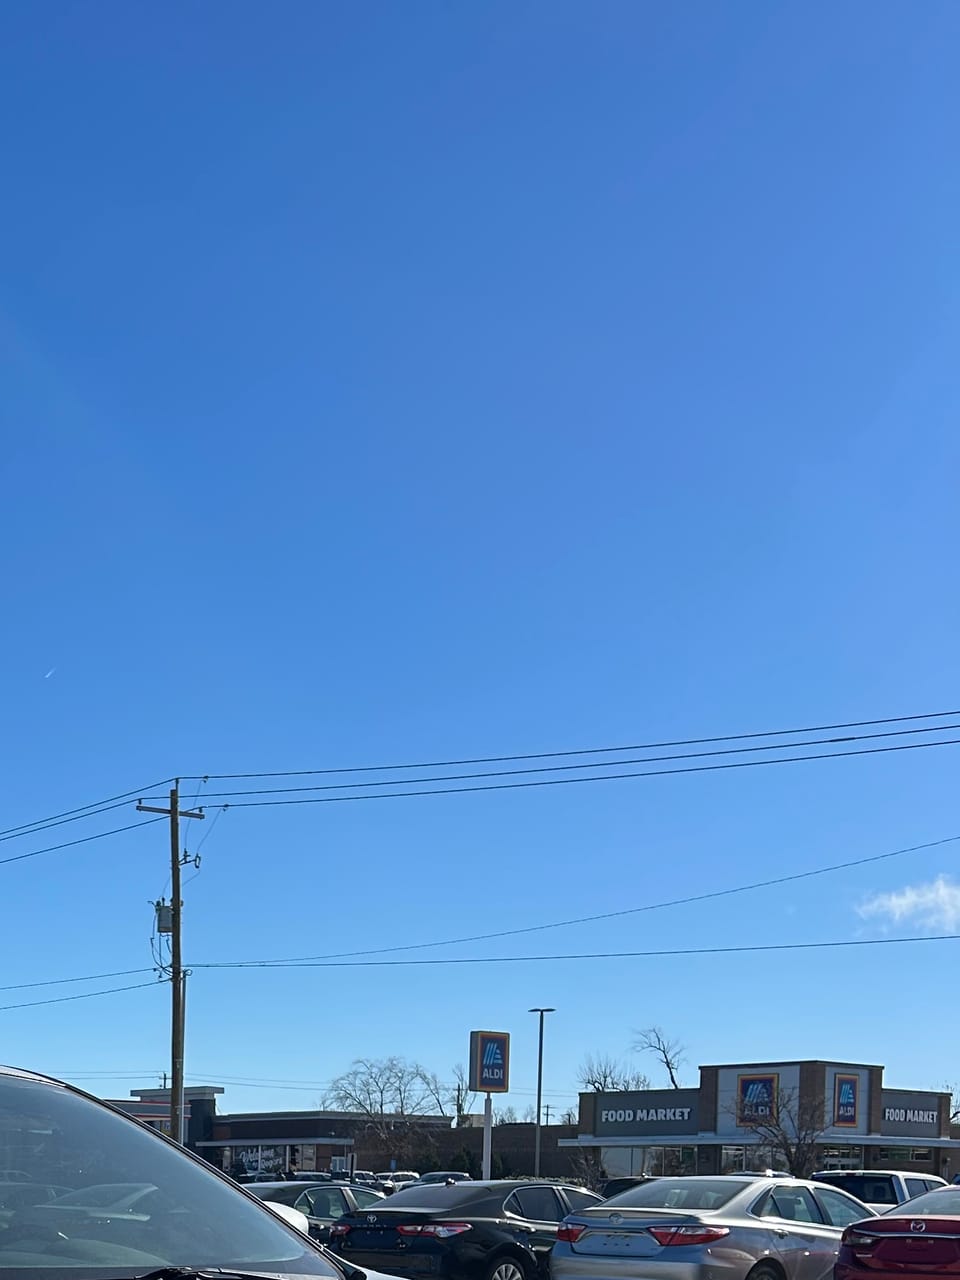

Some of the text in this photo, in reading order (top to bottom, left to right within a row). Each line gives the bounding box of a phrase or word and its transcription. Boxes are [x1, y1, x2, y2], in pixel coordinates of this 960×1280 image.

[483, 1068, 503, 1079] ALDI
[602, 1108, 690, 1122] FOOD MARKET
[745, 1105, 770, 1116] ALDI
[840, 1106, 855, 1116] ALDI
[885, 1108, 938, 1123] FOOD MARKET
